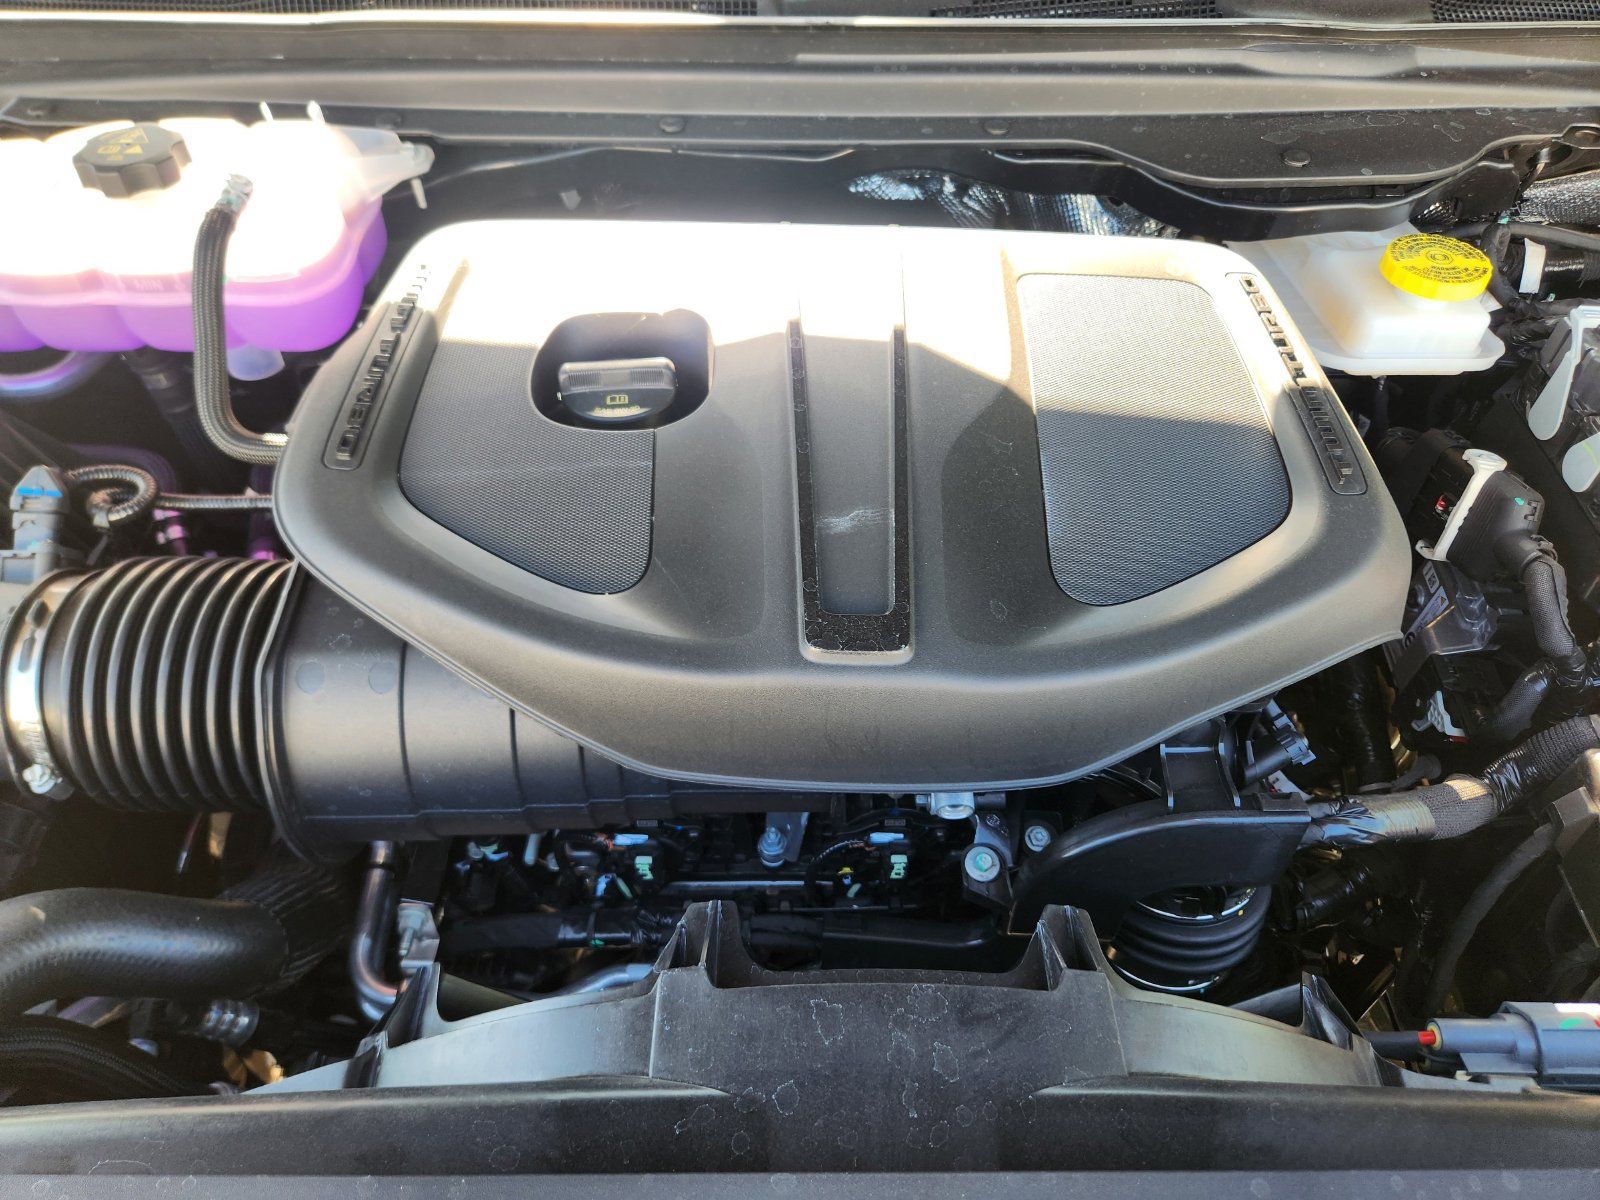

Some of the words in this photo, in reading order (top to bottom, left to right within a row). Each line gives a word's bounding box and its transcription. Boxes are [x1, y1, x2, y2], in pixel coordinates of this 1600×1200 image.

[134, 278, 163, 291] MIN
[1239, 275, 1307, 379] TURBO
[336, 331, 401, 460] TURBO
[1300, 377, 1353, 484] TWIN
